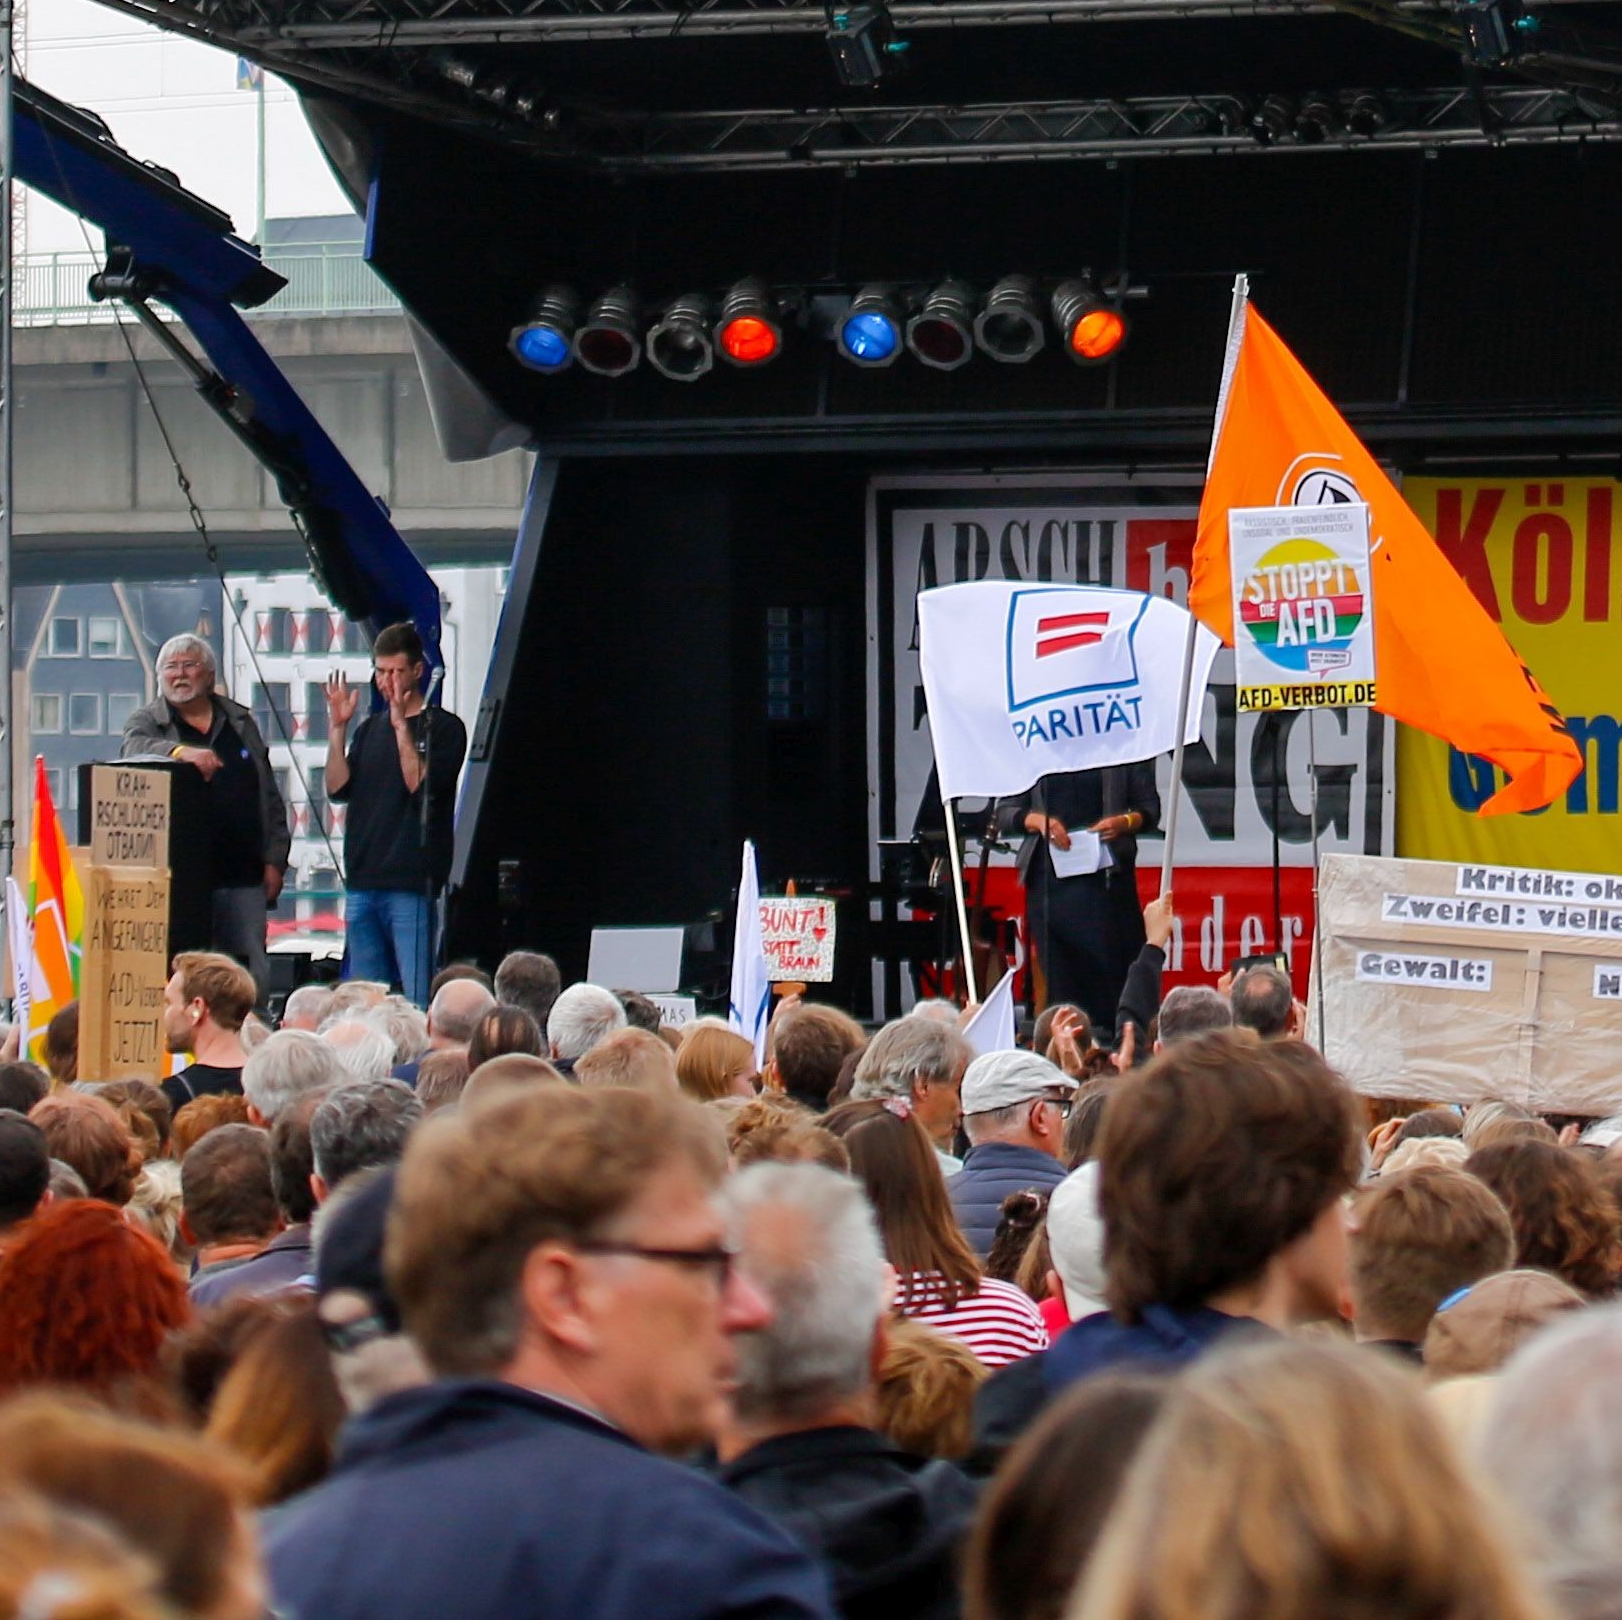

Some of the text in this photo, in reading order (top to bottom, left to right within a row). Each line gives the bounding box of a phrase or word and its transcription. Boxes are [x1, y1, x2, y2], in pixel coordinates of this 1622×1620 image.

[1246, 558, 1351, 606] STOPPT
[1258, 598, 1337, 648] DIE AFD
[1239, 683, 1377, 709] AFD-VERBOT.DE
[1011, 693, 1143, 751] PARITÄT
[1460, 868, 1574, 899] Kritik:
[1385, 894, 1526, 926] Zweifel:
[779, 955, 821, 971] BRAUN
[1360, 953, 1486, 984] Gewalt:
[113, 1018, 160, 1064] JETZT!
